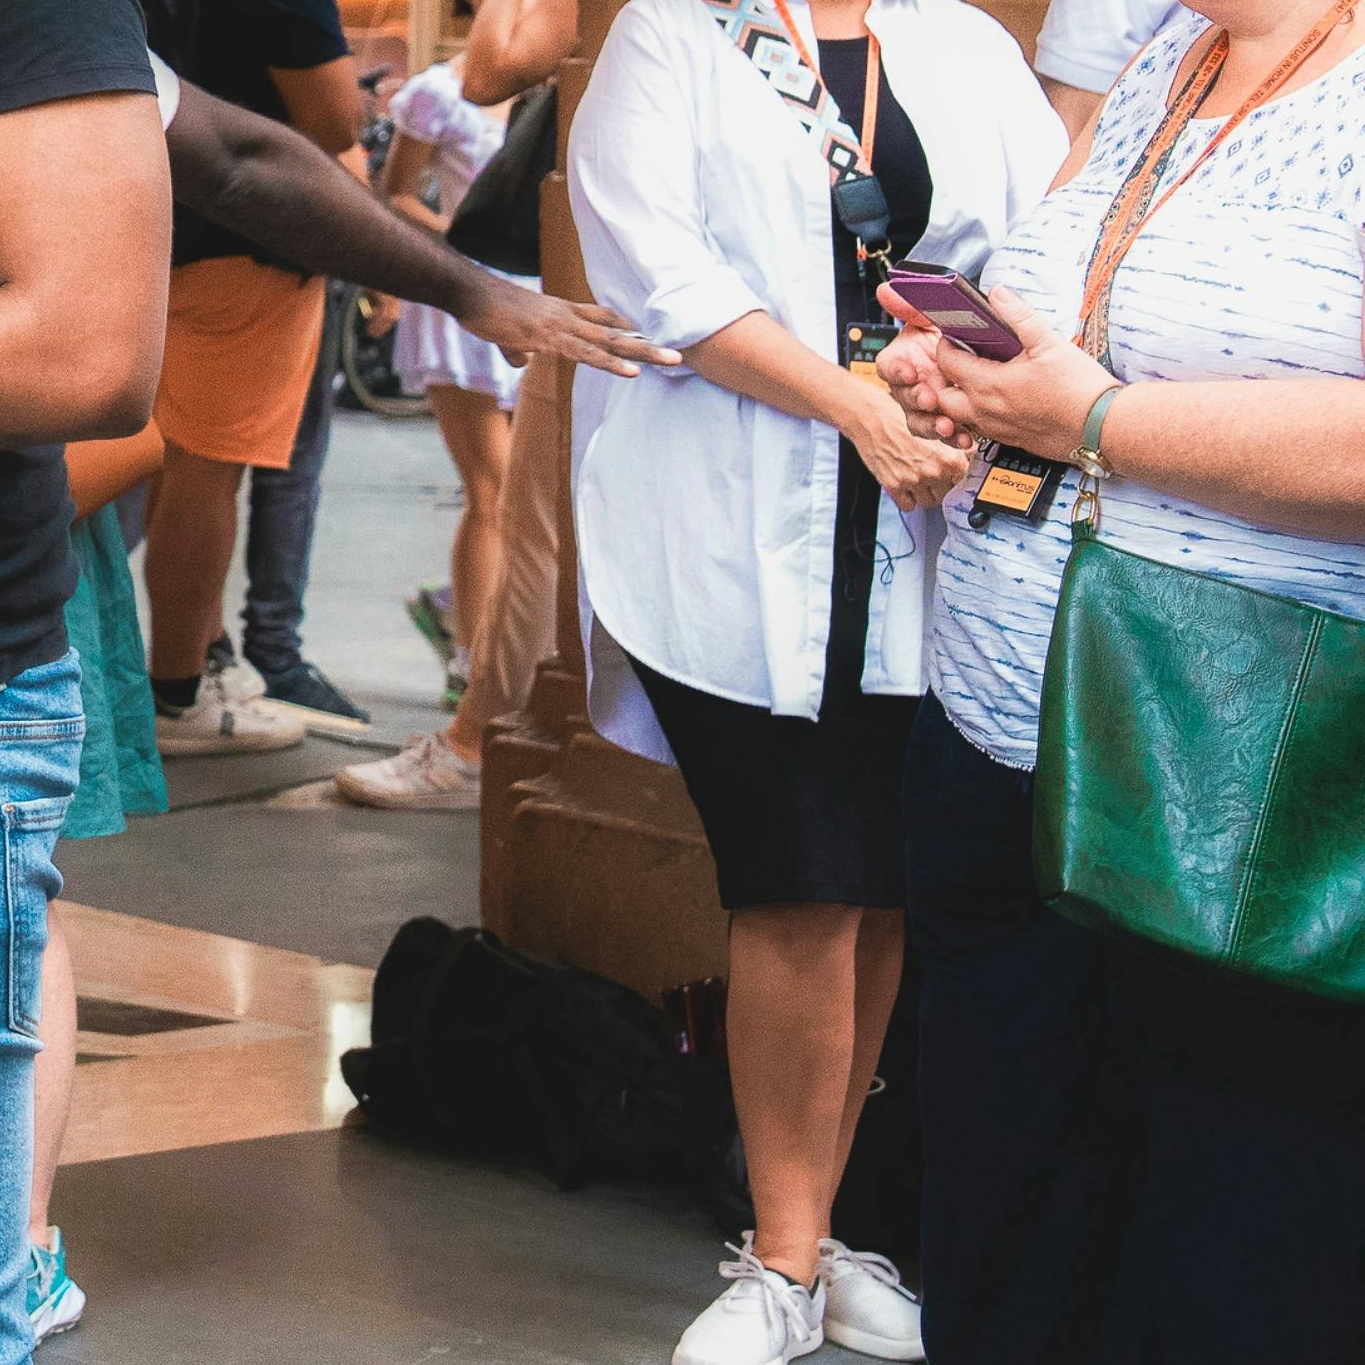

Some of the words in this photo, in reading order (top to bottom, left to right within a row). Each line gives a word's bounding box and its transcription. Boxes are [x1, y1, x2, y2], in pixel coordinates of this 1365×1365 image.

[1290, 29, 1322, 62] SONITUS
[1282, 60, 1293, 71] IN
[1263, 69, 1285, 91] ROME
